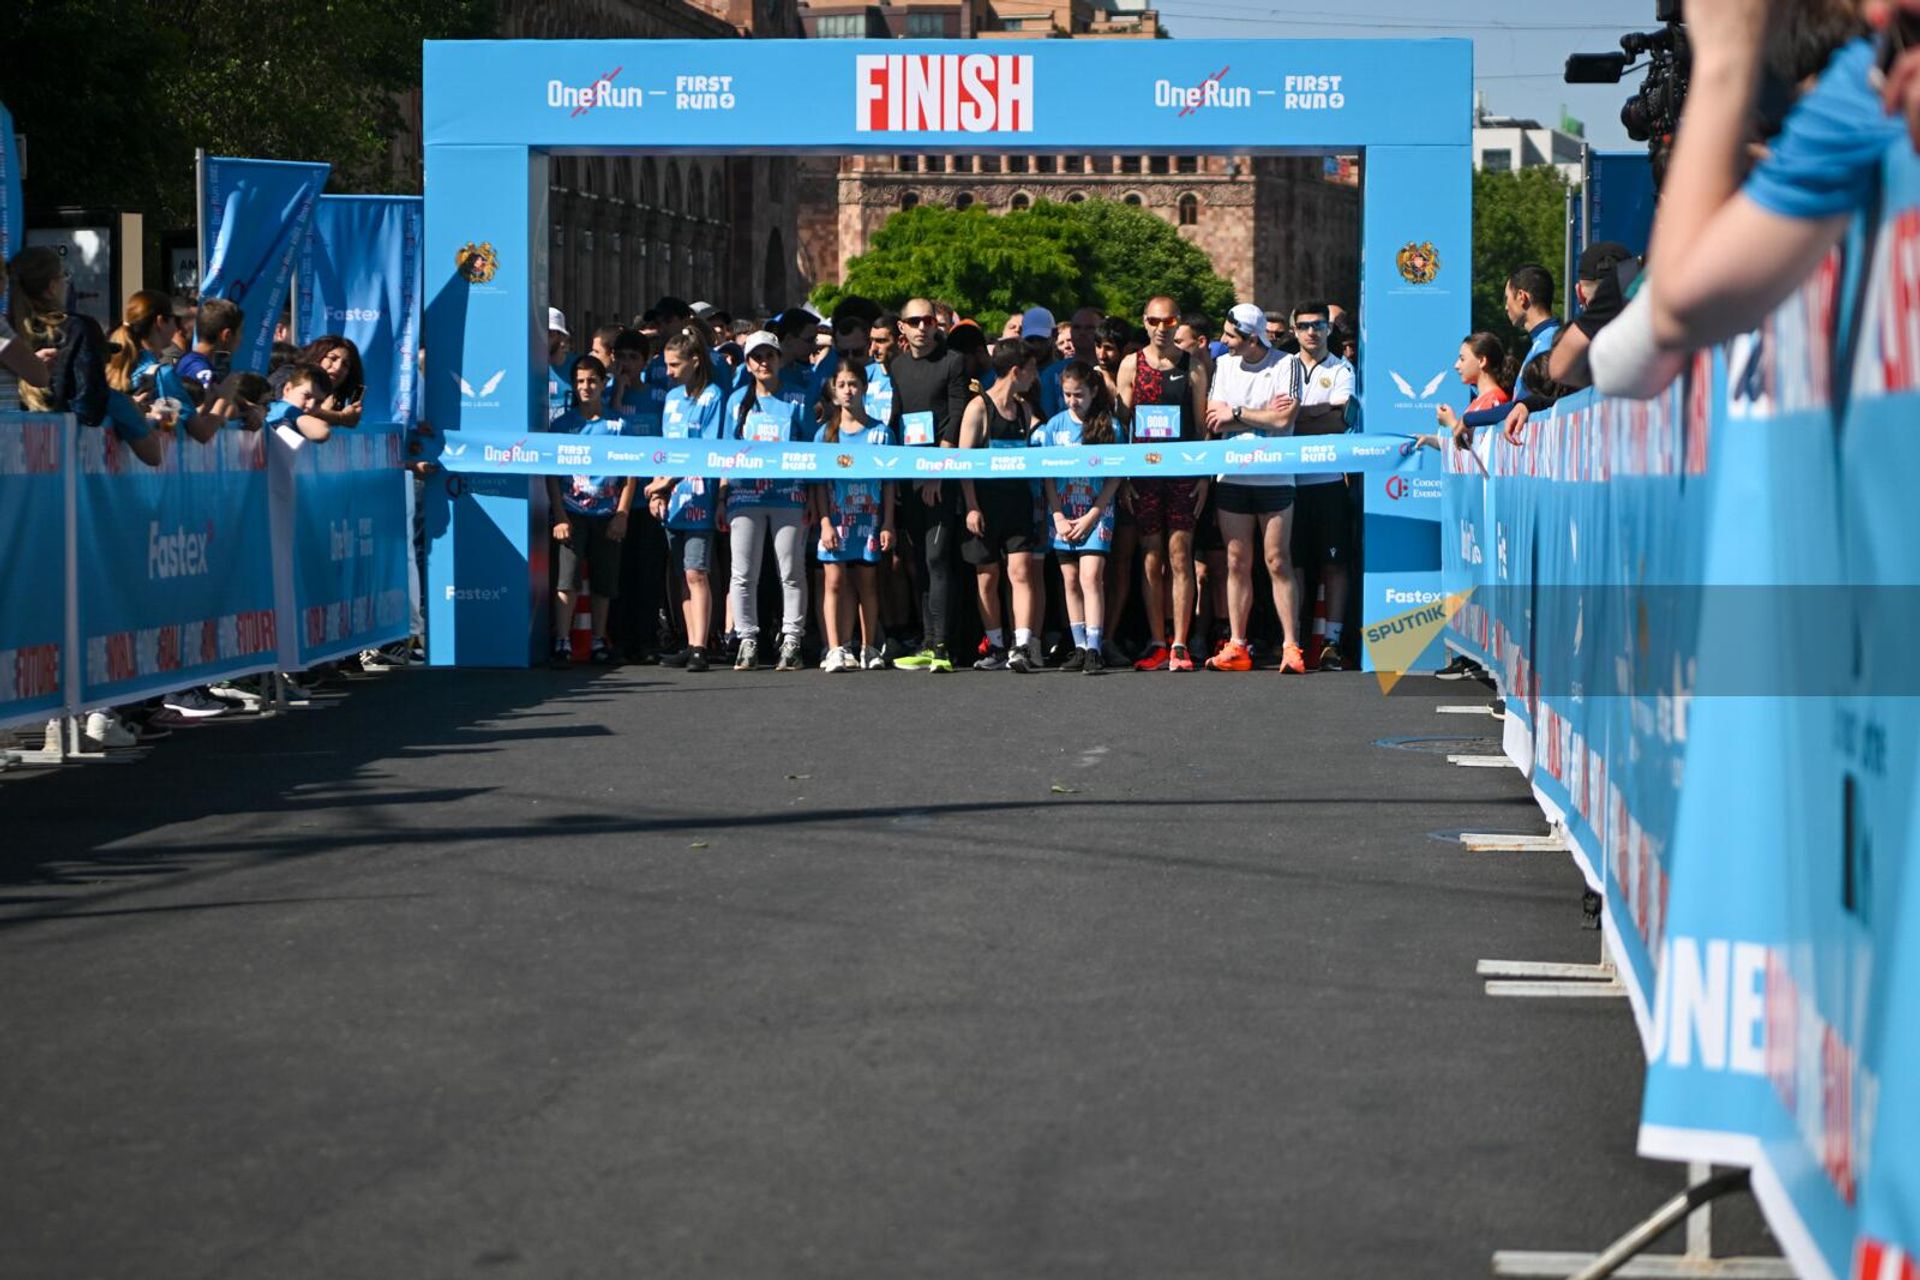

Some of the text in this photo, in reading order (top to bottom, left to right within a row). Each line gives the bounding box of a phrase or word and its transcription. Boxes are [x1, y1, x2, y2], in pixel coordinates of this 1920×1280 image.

[676, 75, 733, 93] FIRST
[1285, 75, 1342, 92] FIRST
[856, 54, 1034, 132] FINISH
[324, 306, 380, 321] Fastex
[558, 445, 591, 455] FIRST
[1301, 445, 1335, 453] FIRST
[782, 453, 816, 462] FIRST
[1412, 478, 1441, 488] Conce
[147, 520, 209, 580] Fastex
[446, 585, 500, 601] Fastex
[1386, 588, 1441, 603] Fastex
